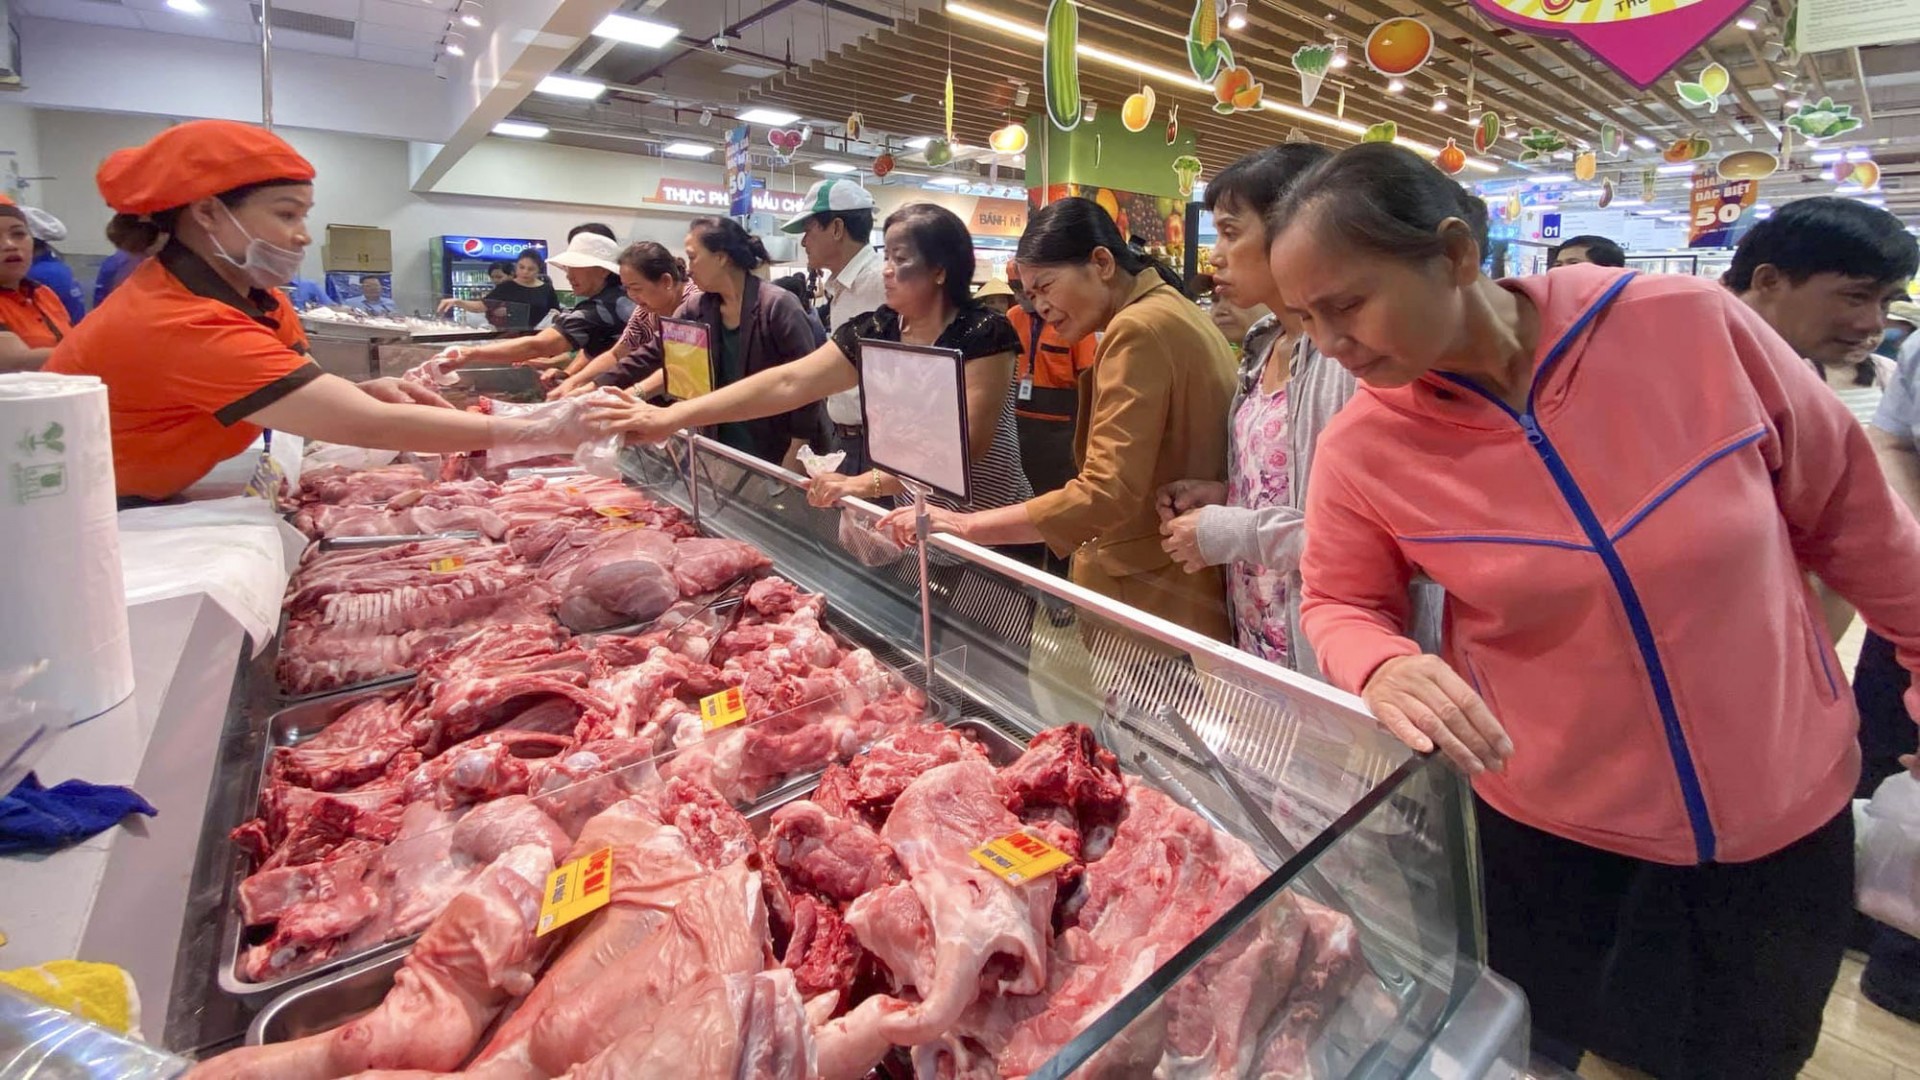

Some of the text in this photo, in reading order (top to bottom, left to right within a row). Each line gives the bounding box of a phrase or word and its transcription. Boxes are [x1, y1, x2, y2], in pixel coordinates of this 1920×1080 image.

[1614, 0, 1649, 12] TH
[708, 190, 730, 207] PH
[1544, 226, 1559, 237] 01
